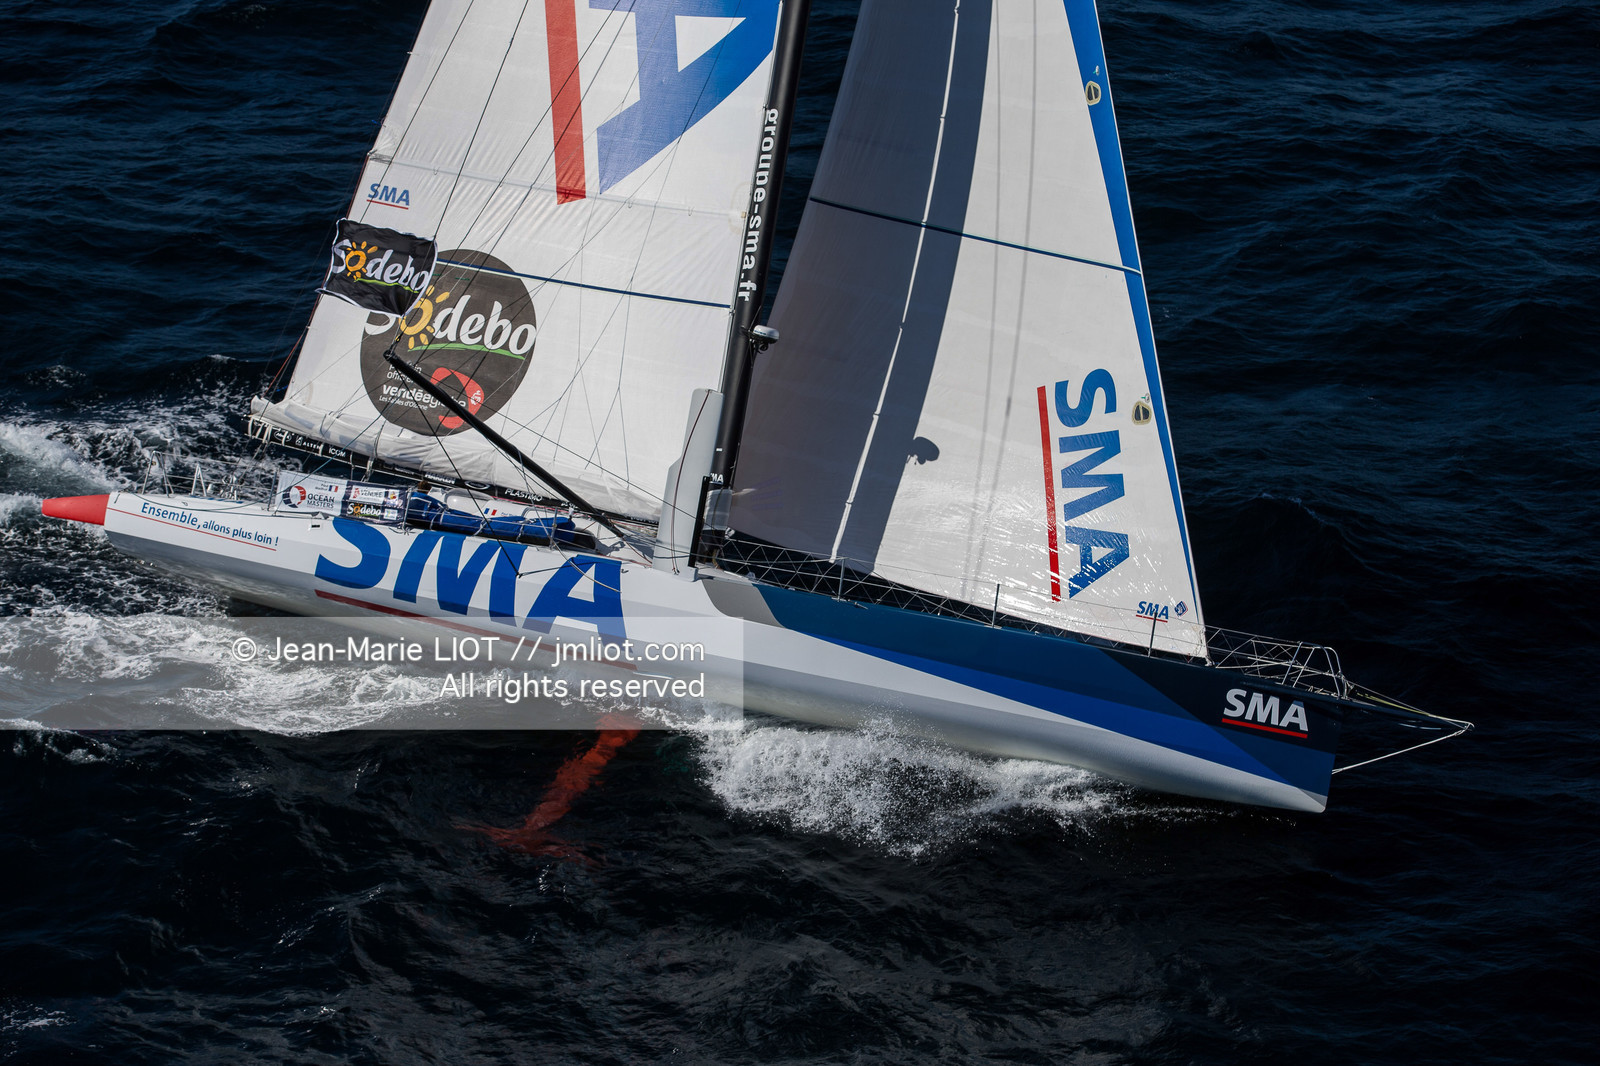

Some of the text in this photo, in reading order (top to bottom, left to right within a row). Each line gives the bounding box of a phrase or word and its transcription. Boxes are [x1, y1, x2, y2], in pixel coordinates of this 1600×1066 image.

[366, 183, 410, 206] SMA
[738, 107, 779, 302] groupe-sma.fr
[333, 239, 430, 292] Sodebo
[307, 492, 335, 503] OCEAN
[504, 487, 543, 502] PLASTIMO
[1055, 368, 1130, 599] SMA
[306, 500, 334, 509] MASTERS
[346, 502, 381, 516] Sodebo
[141, 502, 279, 547] Ensemble, allons plus loin !
[314, 516, 633, 653] SMA
[1136, 600, 1169, 620] SMA
[1223, 688, 1309, 732] SMA
